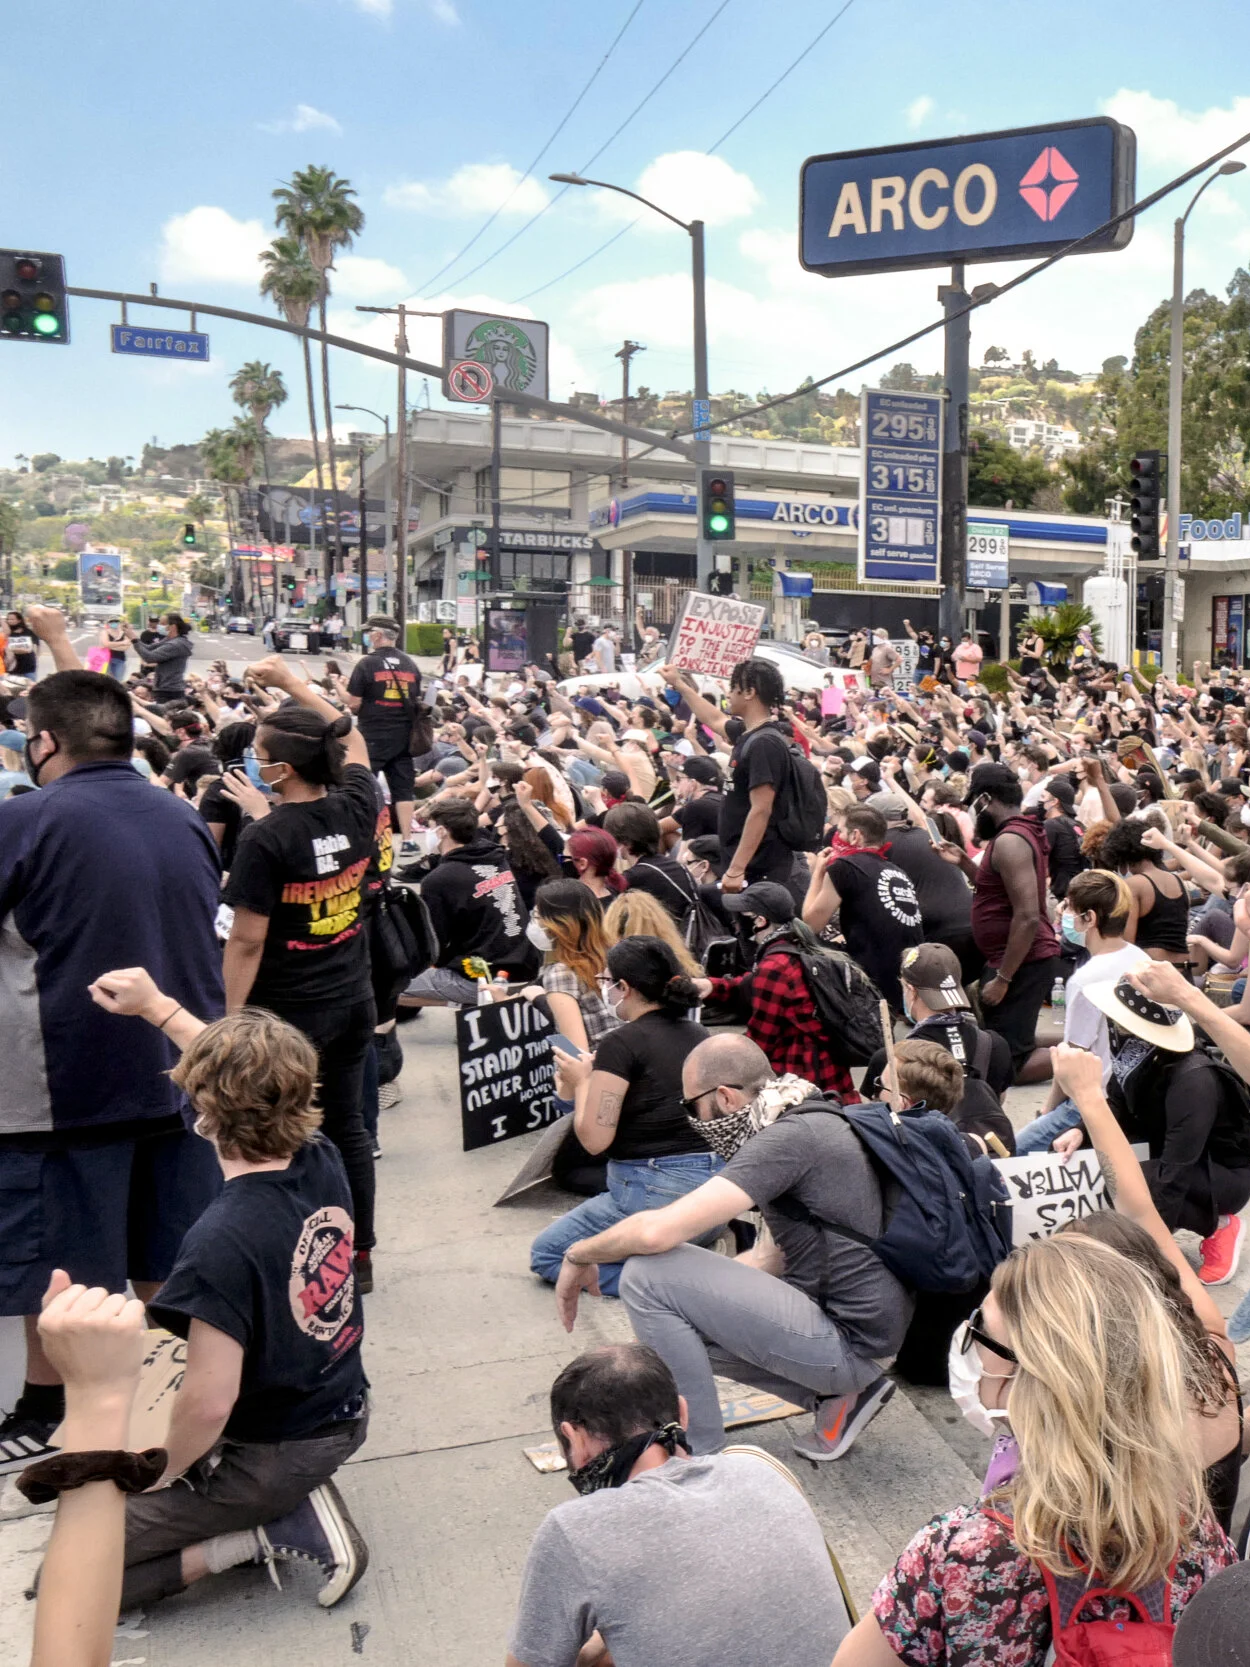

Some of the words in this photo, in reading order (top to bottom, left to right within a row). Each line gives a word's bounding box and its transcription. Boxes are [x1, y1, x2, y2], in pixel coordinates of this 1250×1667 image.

[828, 163, 997, 238] ARCO
[120, 331, 199, 353] Fairfax
[872, 412, 924, 440] 295
[871, 465, 924, 492] 315
[773, 500, 838, 525] ARCO
[871, 517, 888, 542] 3
[1178, 512, 1242, 541] Food
[498, 532, 594, 549] TARBUCKS
[968, 536, 997, 555] 299
[689, 596, 763, 626] EXPOSE
[679, 633, 696, 647] TO
[702, 638, 722, 652] THE
[681, 616, 760, 646] INJUSTICE
[672, 654, 734, 678] CONSCIENC
[700, 649, 717, 660] THE
[464, 1009, 489, 1051] I
[461, 1045, 522, 1086] STAND
[525, 1039, 550, 1059] THA
[466, 1075, 522, 1112] NEVER
[529, 1064, 559, 1087] UND
[520, 1082, 553, 1103] HOWEV
[491, 1115, 507, 1138] I
[1009, 1160, 1102, 1199] MATTER
[297, 1229, 352, 1320] RAW
